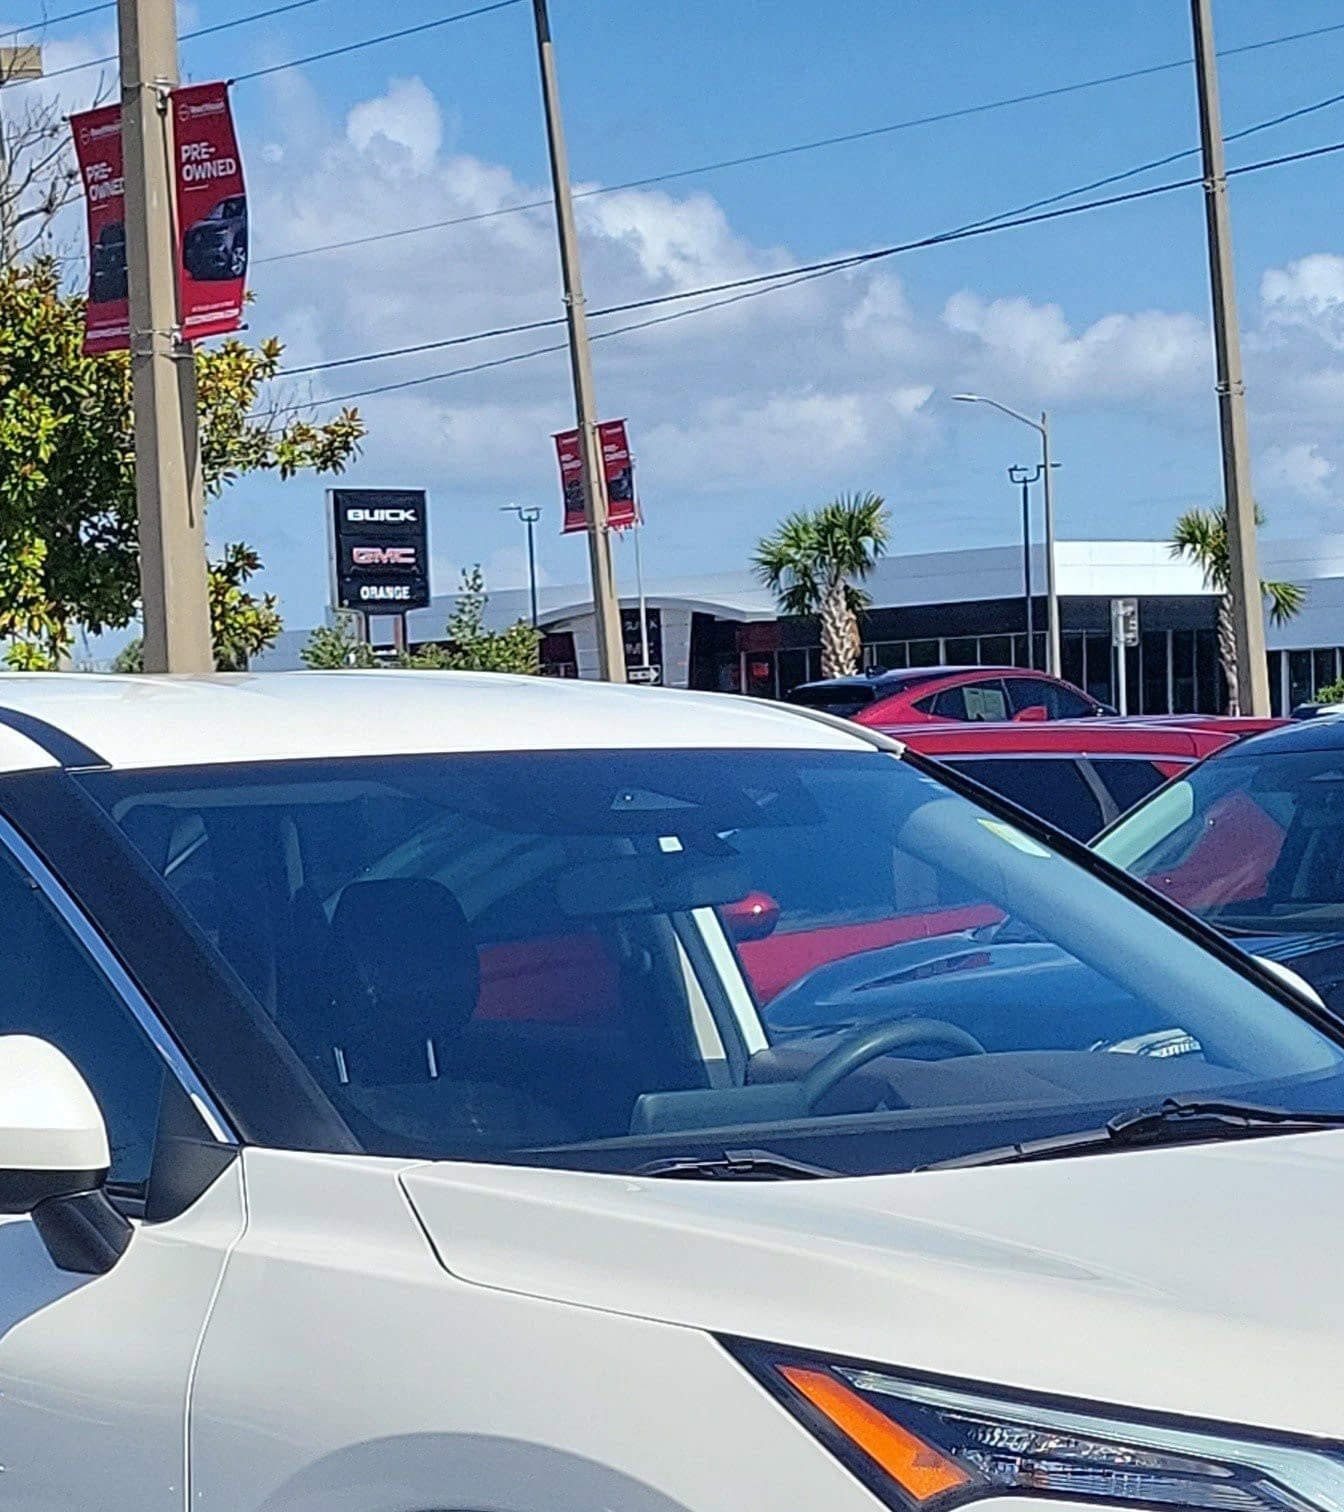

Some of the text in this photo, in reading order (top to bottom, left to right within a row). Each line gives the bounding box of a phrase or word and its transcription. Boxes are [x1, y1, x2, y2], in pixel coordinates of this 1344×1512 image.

[181, 142, 216, 162] PRE-
[182, 158, 236, 181] OWNED
[347, 509, 417, 521] BUICK
[353, 547, 416, 564] GMC
[360, 586, 411, 600] ORANGE
